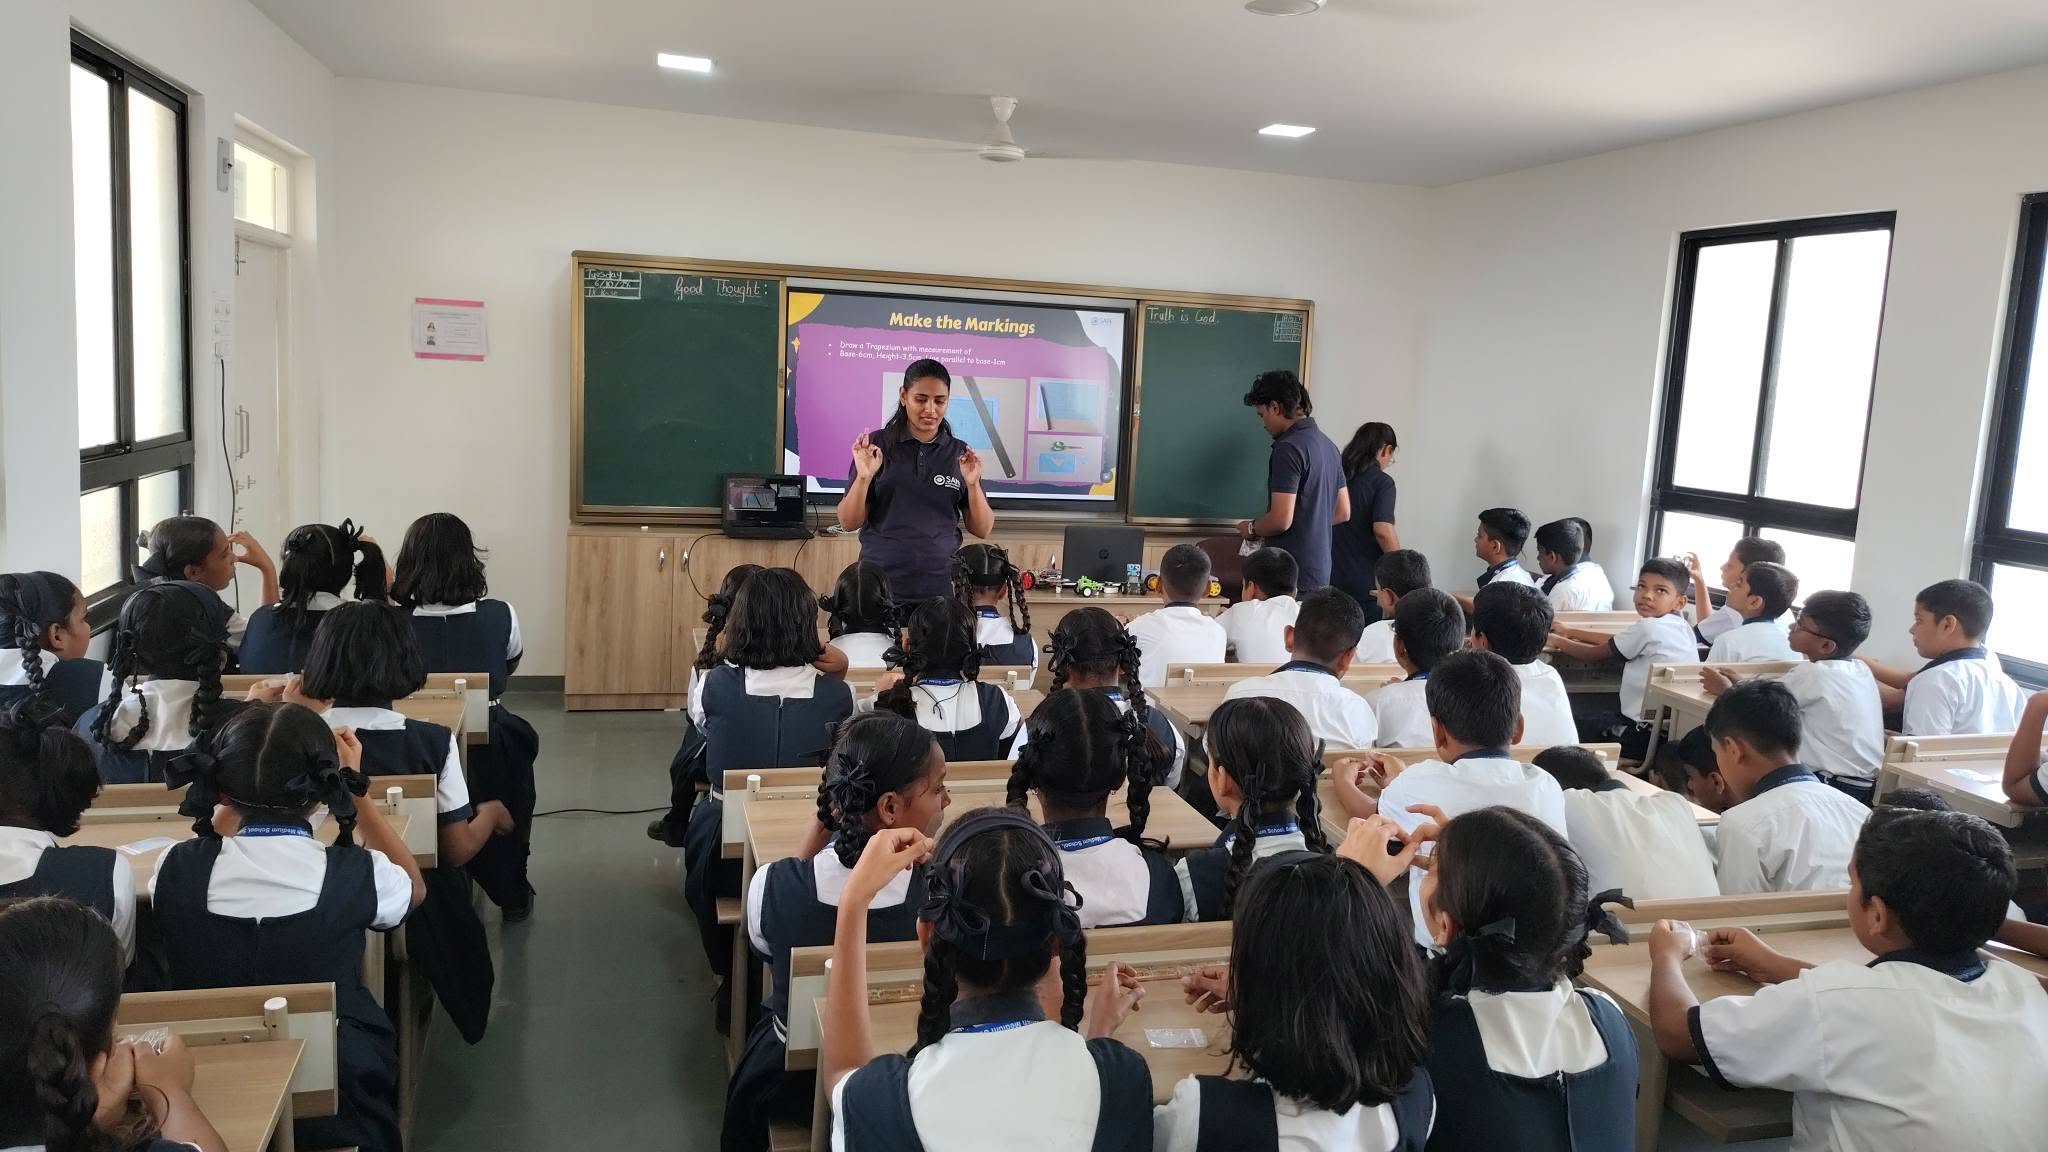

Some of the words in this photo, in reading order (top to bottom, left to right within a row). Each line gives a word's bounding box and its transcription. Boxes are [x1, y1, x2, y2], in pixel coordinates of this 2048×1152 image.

[674, 276, 704, 301] Good
[1147, 307, 1175, 321] Truth
[1180, 309, 1189, 321] is
[889, 312, 932, 328] Make
[936, 314, 962, 330] the
[965, 317, 1036, 337] Markings
[840, 341, 858, 349] Draw
[866, 342, 901, 352] Trapezium
[902, 344, 918, 352] with
[918, 346, 962, 355] measurement
[963, 348, 972, 356] of
[940, 355, 966, 364] parallel
